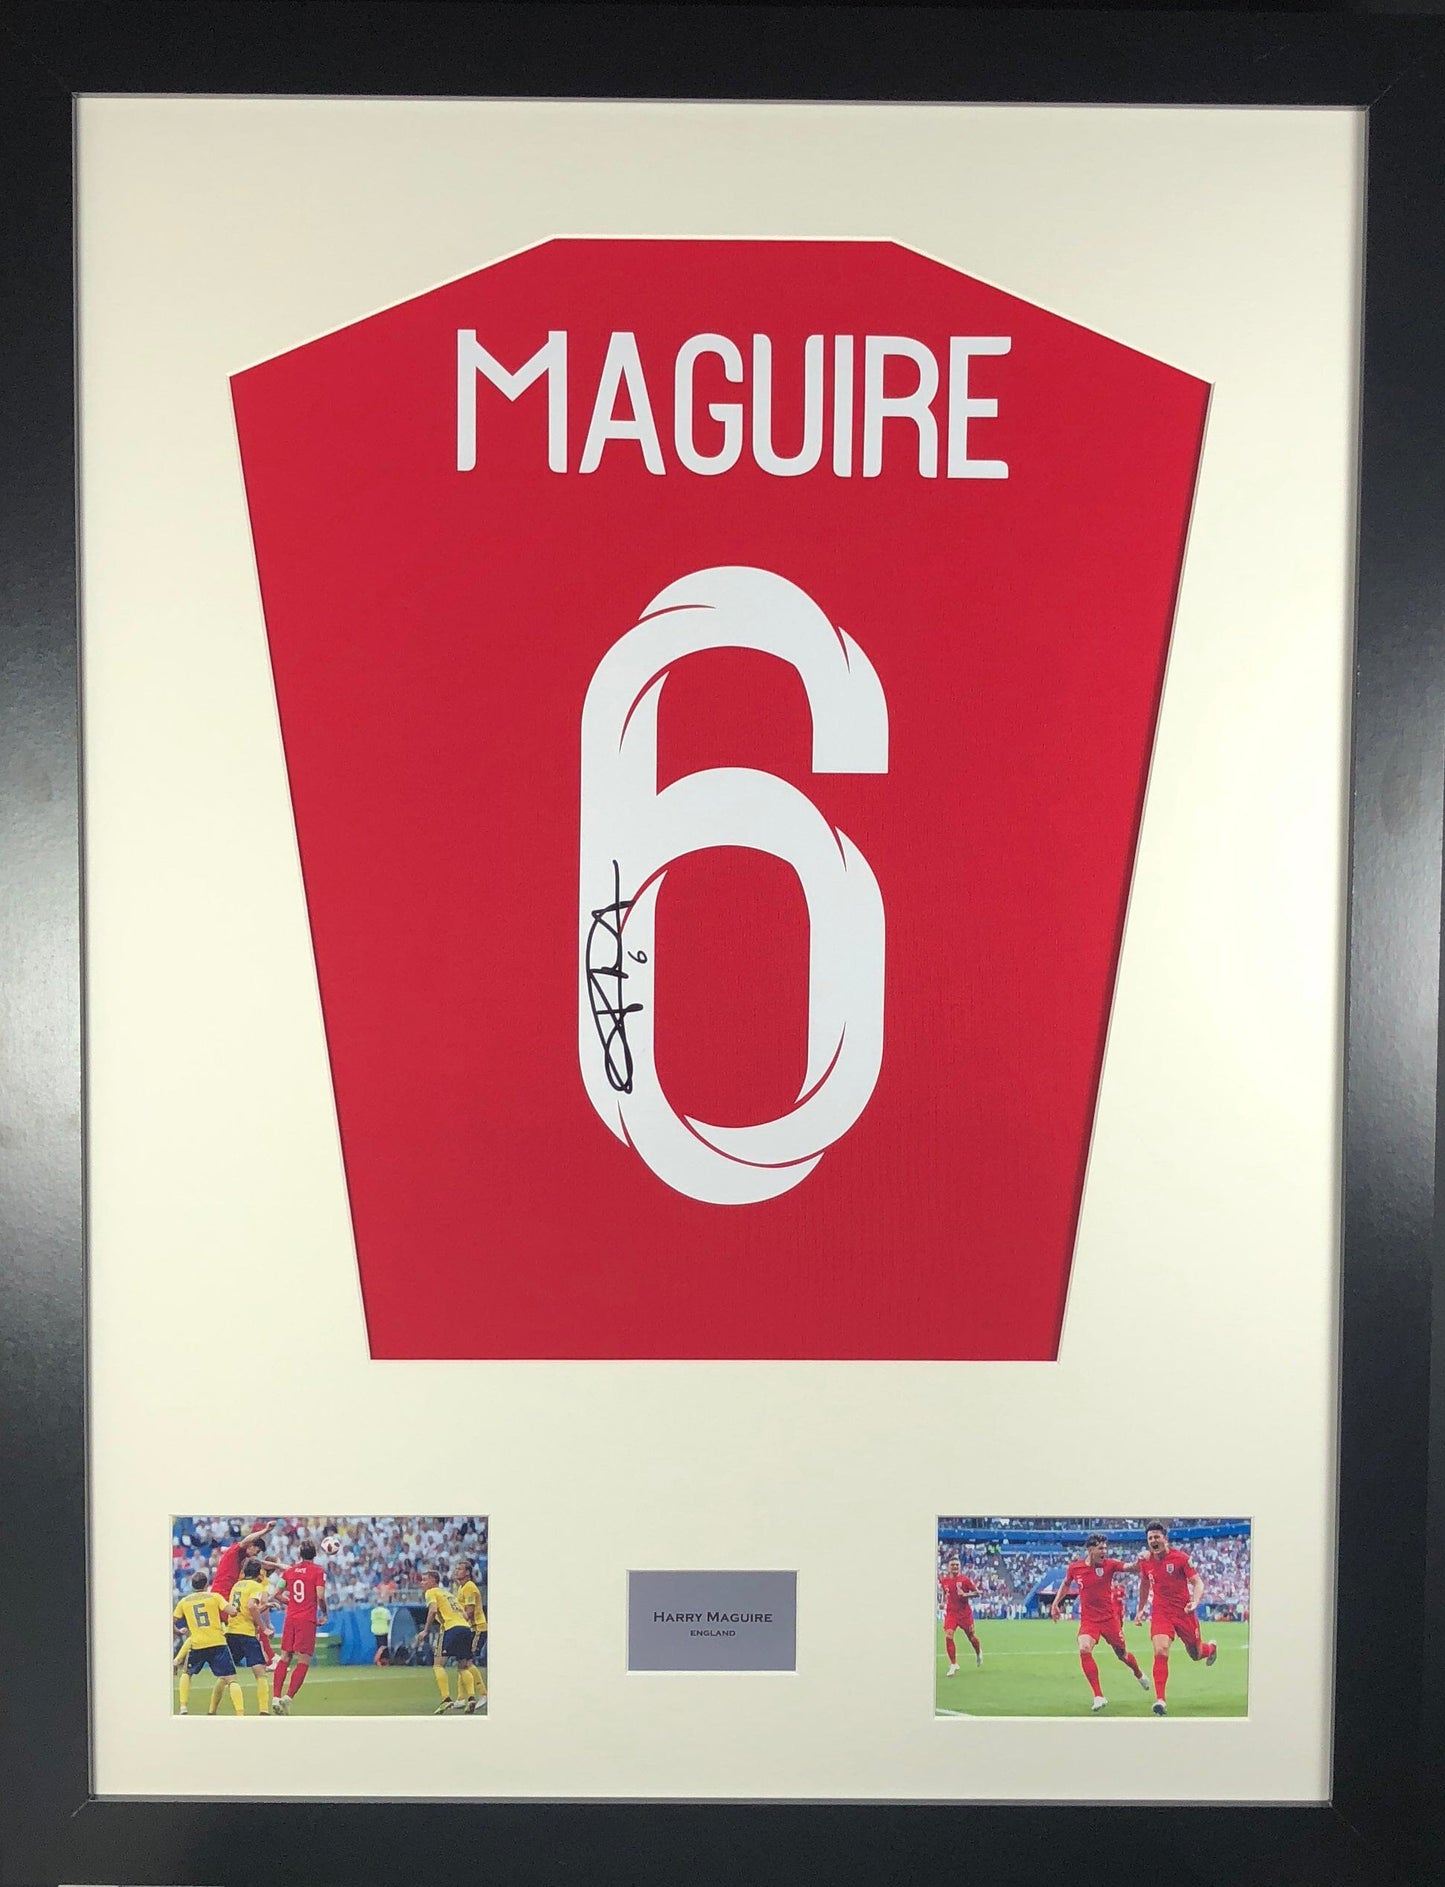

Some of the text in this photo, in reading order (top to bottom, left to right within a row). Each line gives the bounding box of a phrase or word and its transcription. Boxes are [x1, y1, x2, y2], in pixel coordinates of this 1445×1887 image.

[456, 328, 1012, 479] MAGUIRE
[579, 565, 889, 1206] 6
[627, 950, 648, 964] 6
[293, 1579, 305, 1603] 9
[193, 1603, 211, 1627] 6
[653, 1611, 773, 1623] HARRY MAGUIRE
[690, 1629, 736, 1637] ENGLAND
